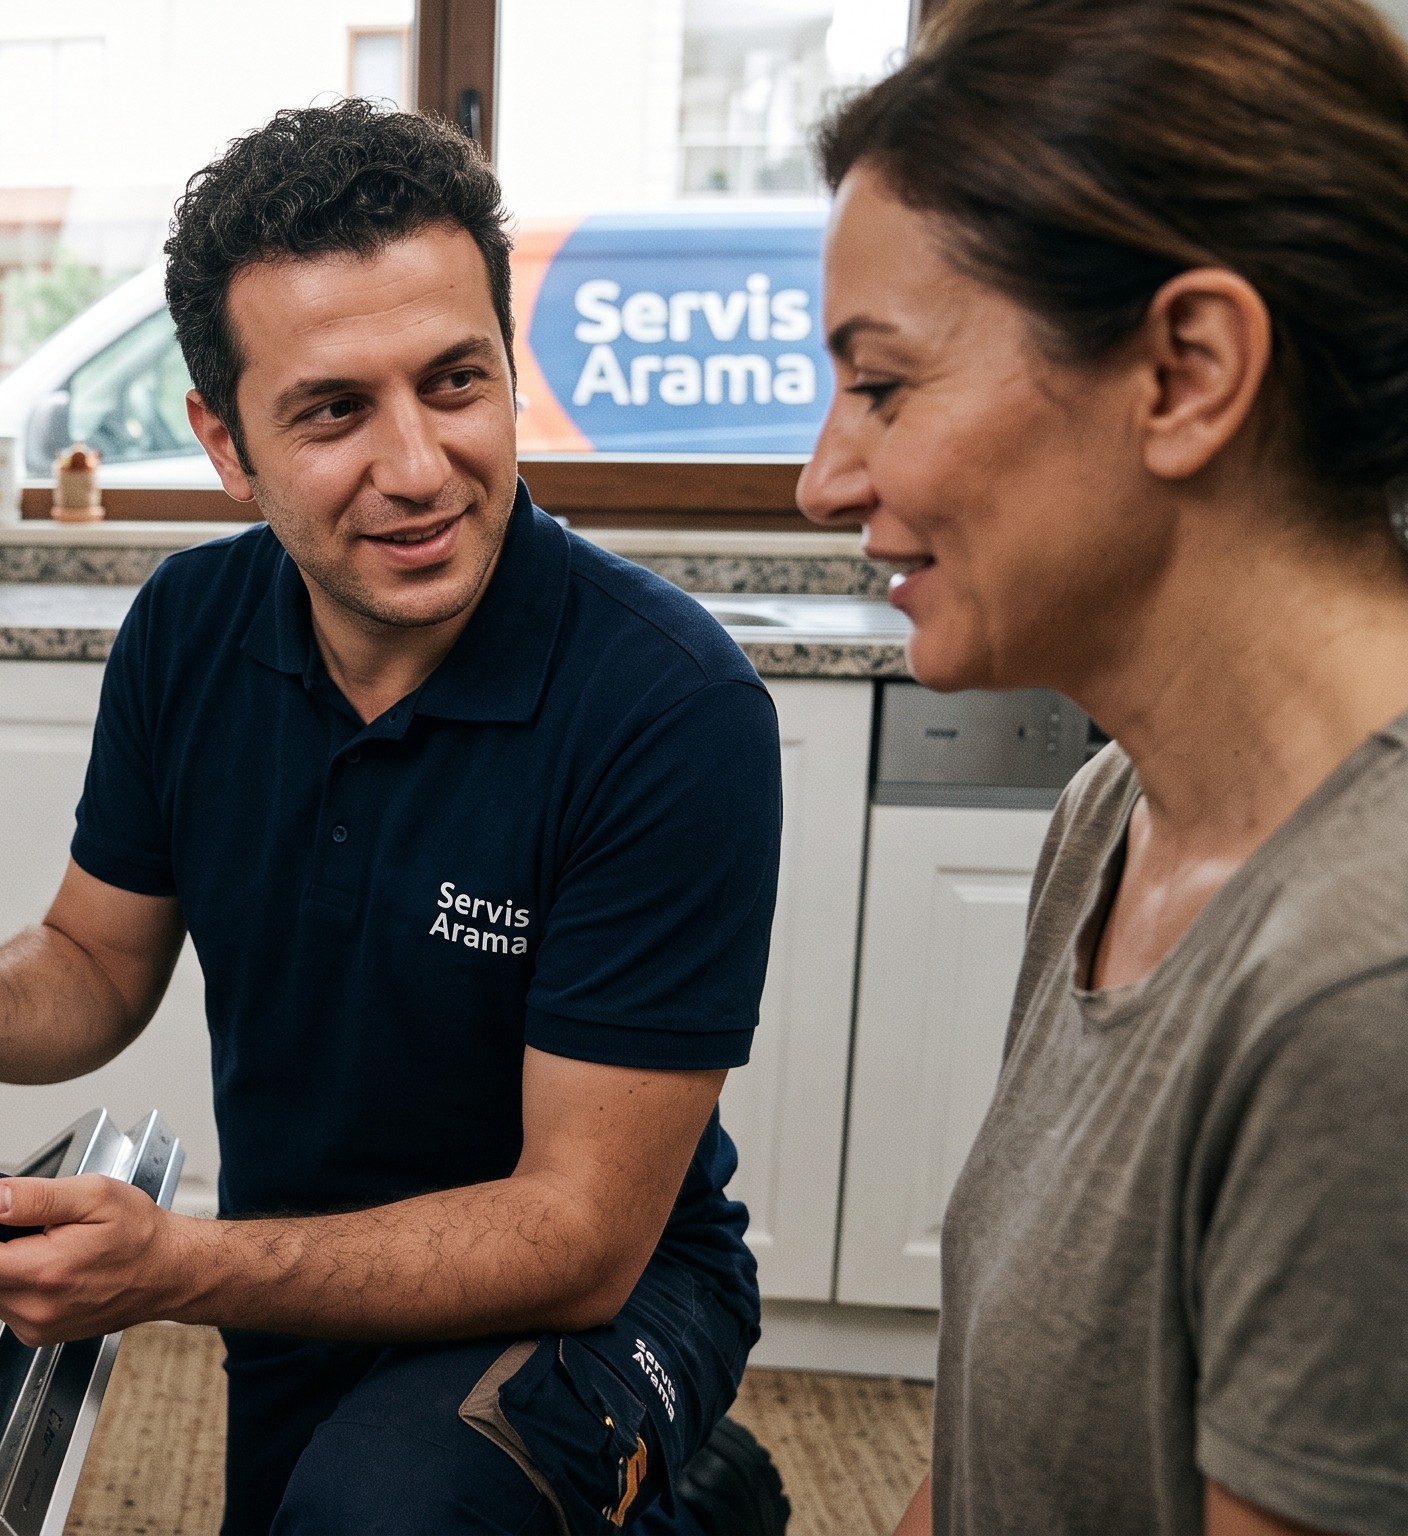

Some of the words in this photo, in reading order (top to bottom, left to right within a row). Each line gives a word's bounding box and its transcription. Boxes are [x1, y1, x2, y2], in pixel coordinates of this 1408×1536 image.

[574, 272, 812, 344] Servis
[572, 344, 817, 406] Arama
[437, 881, 530, 928] Servis
[428, 911, 528, 955] Arama
